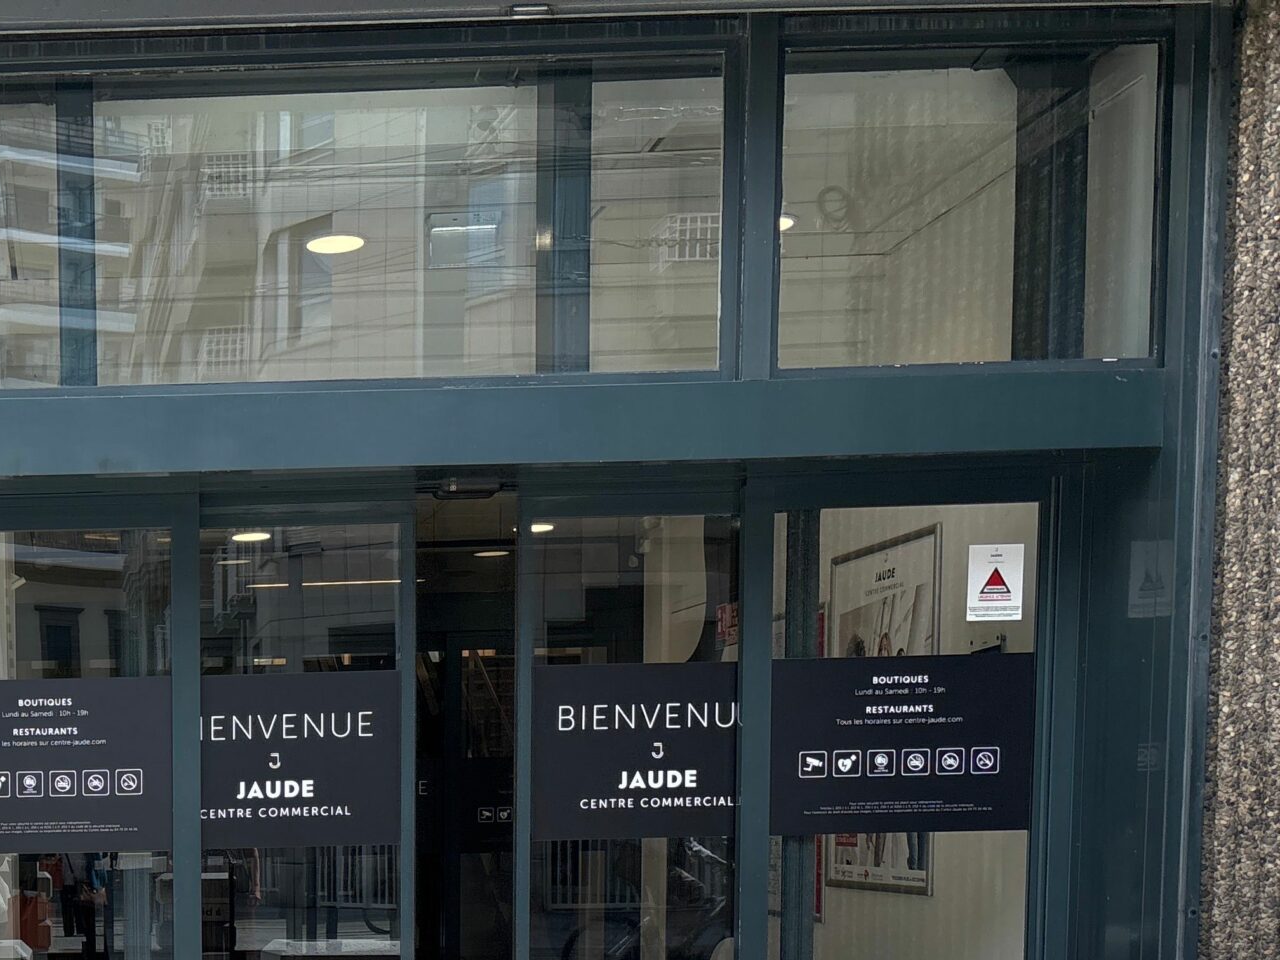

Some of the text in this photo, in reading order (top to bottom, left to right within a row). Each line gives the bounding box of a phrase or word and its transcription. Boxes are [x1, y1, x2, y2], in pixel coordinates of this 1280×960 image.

[875, 567, 896, 583] JAUDE
[873, 675, 928, 684] BOUTIQUES
[854, 688, 873, 696] Lundi
[884, 687, 909, 695] Samedi
[933, 686, 946, 694] 19h
[18, 698, 72, 706] BOUTIQUES
[30, 710, 54, 718] Samedi
[866, 705, 933, 713] RESTAURANTS
[836, 718, 852, 726] Tous
[853, 717, 863, 726] les
[864, 717, 892, 725] horaires
[904, 715, 963, 725] centre-jaude.com
[50, 738, 107, 747] centre-jaude.com
[618, 770, 697, 789] JAUDE
[236, 780, 314, 799] JAUDE
[580, 796, 734, 809] CENTRE COMMERCIAL
[200, 805, 351, 819] CENTRE COMMERCIAL
